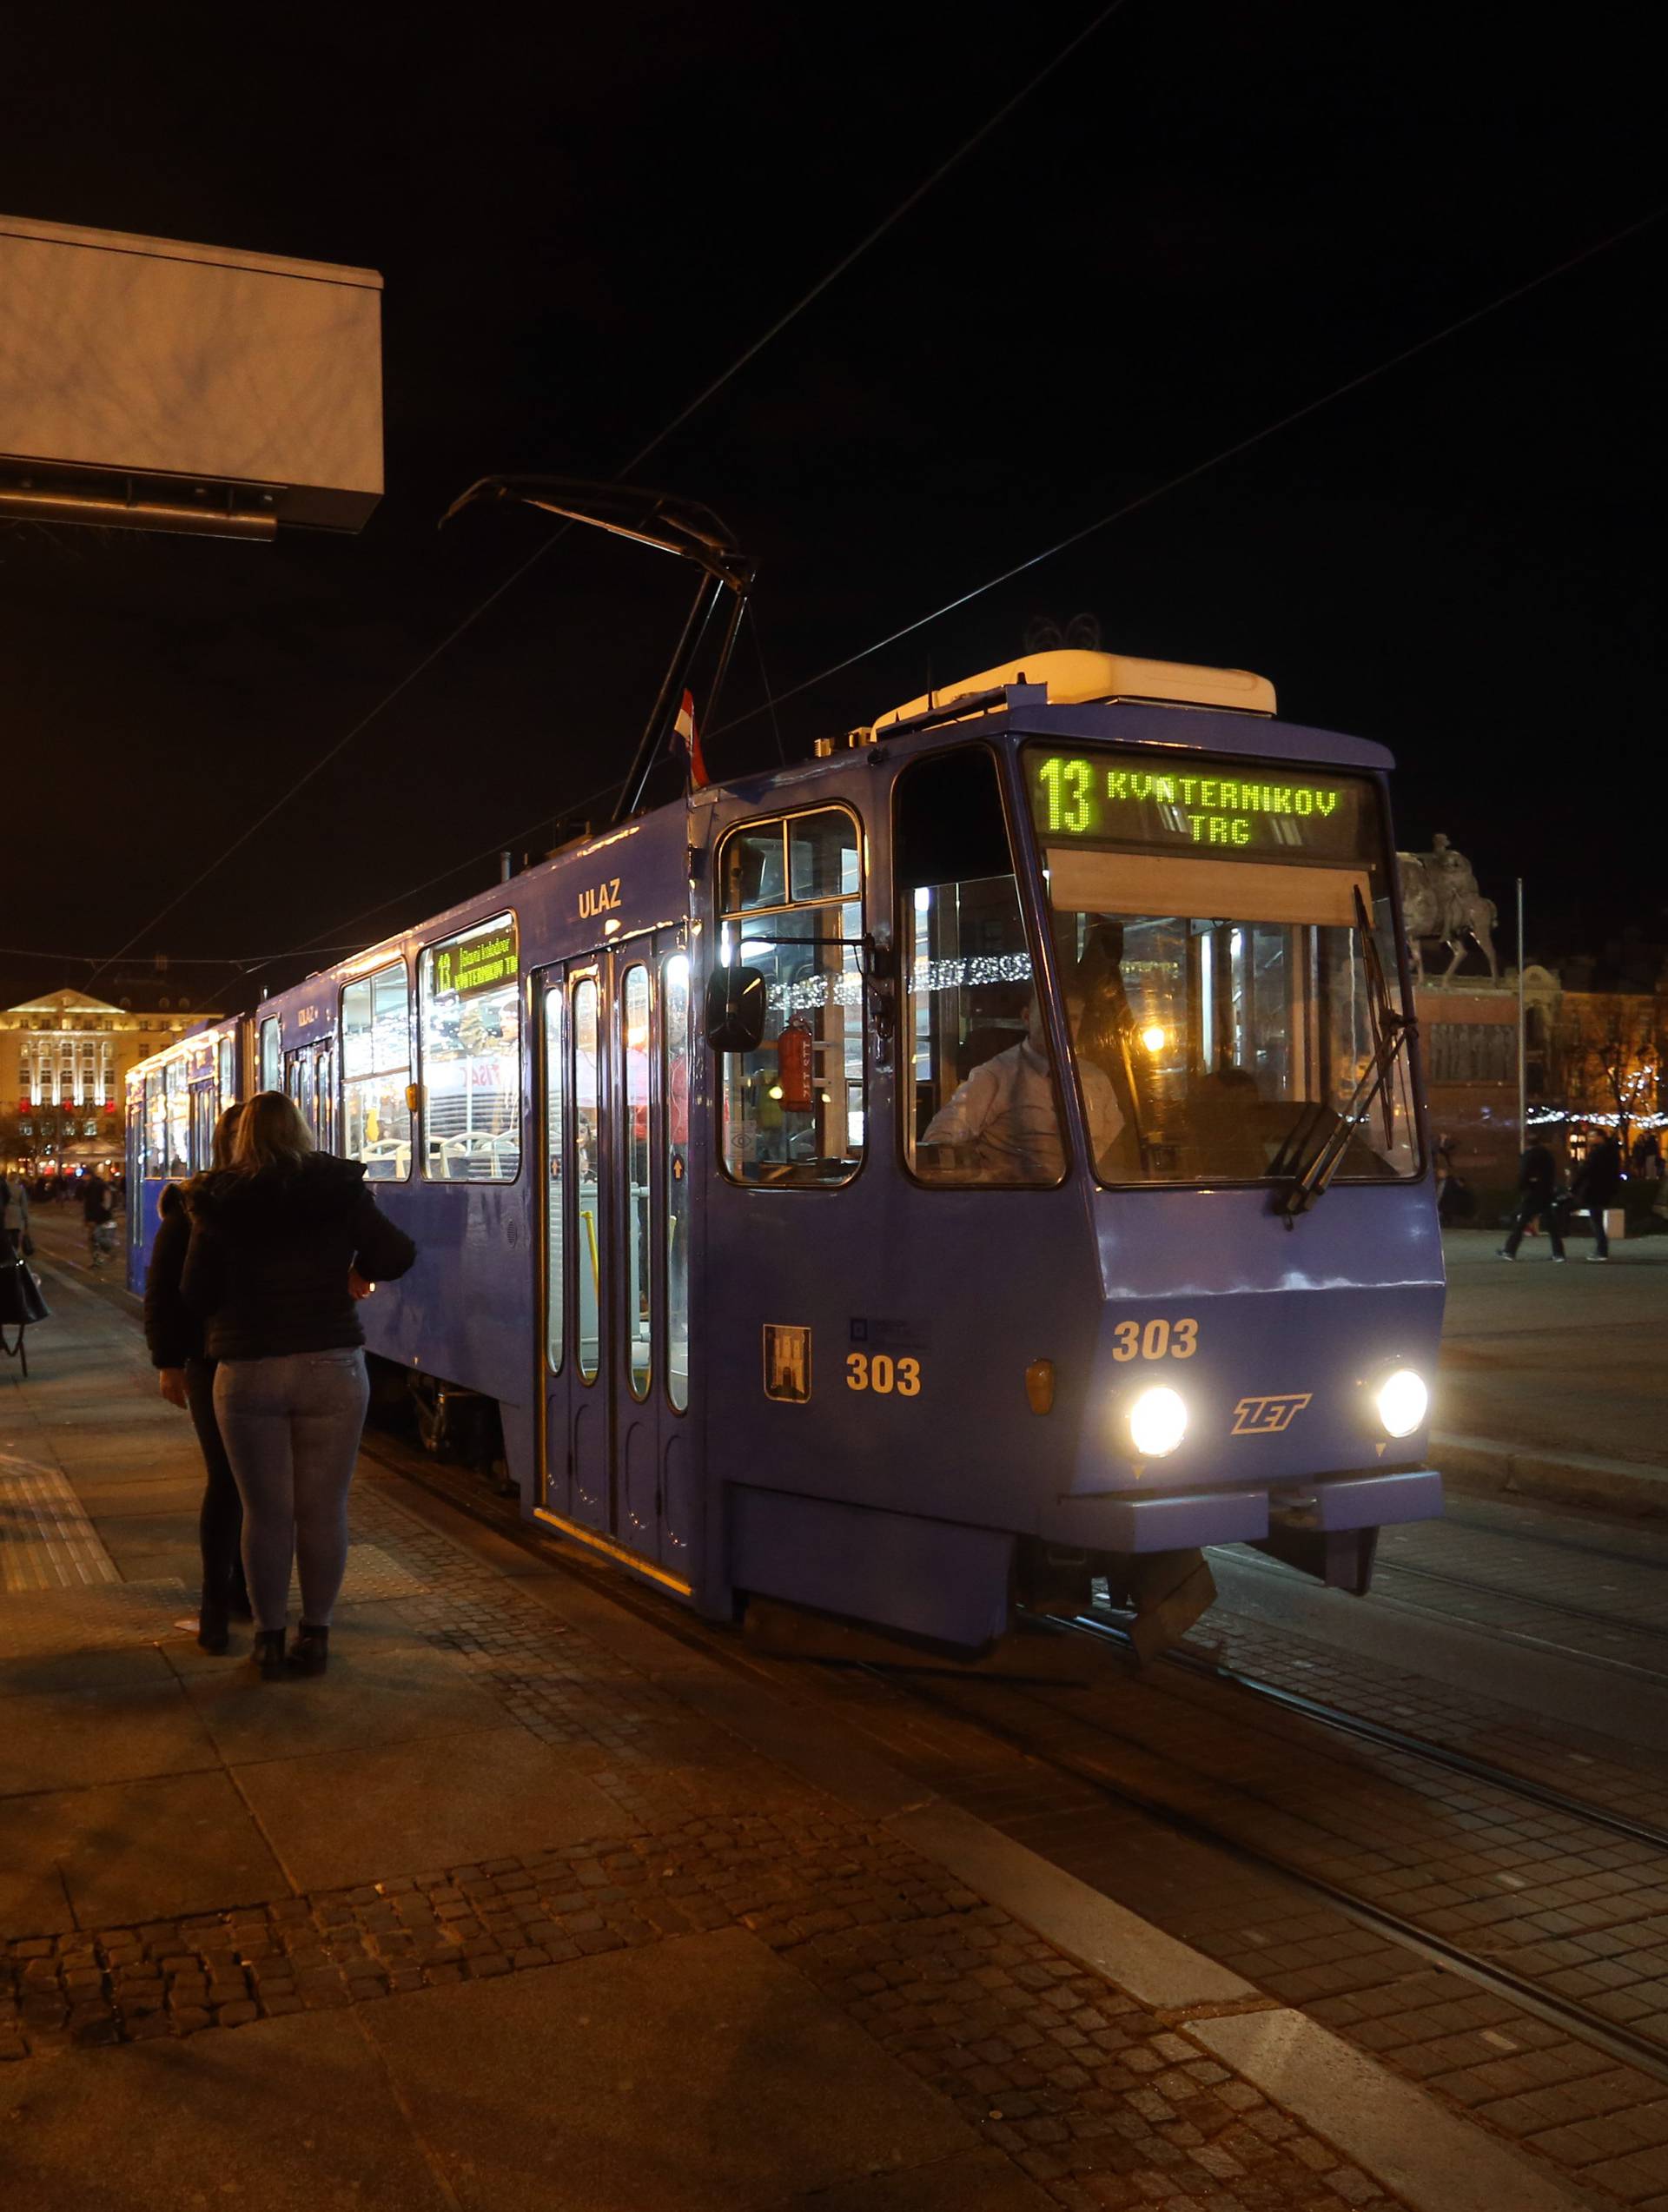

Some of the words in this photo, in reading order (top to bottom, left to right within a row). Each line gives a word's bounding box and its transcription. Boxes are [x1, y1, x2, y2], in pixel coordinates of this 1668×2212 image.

[1039, 758, 1092, 832] 13
[1106, 771, 1336, 818] KVATERNIKOV
[1188, 814, 1250, 845] TRG
[579, 877, 622, 919] ULAZ
[1112, 1317, 1199, 1362] 303
[845, 1352, 922, 1397] 303
[1230, 1392, 1314, 1436] ZET
